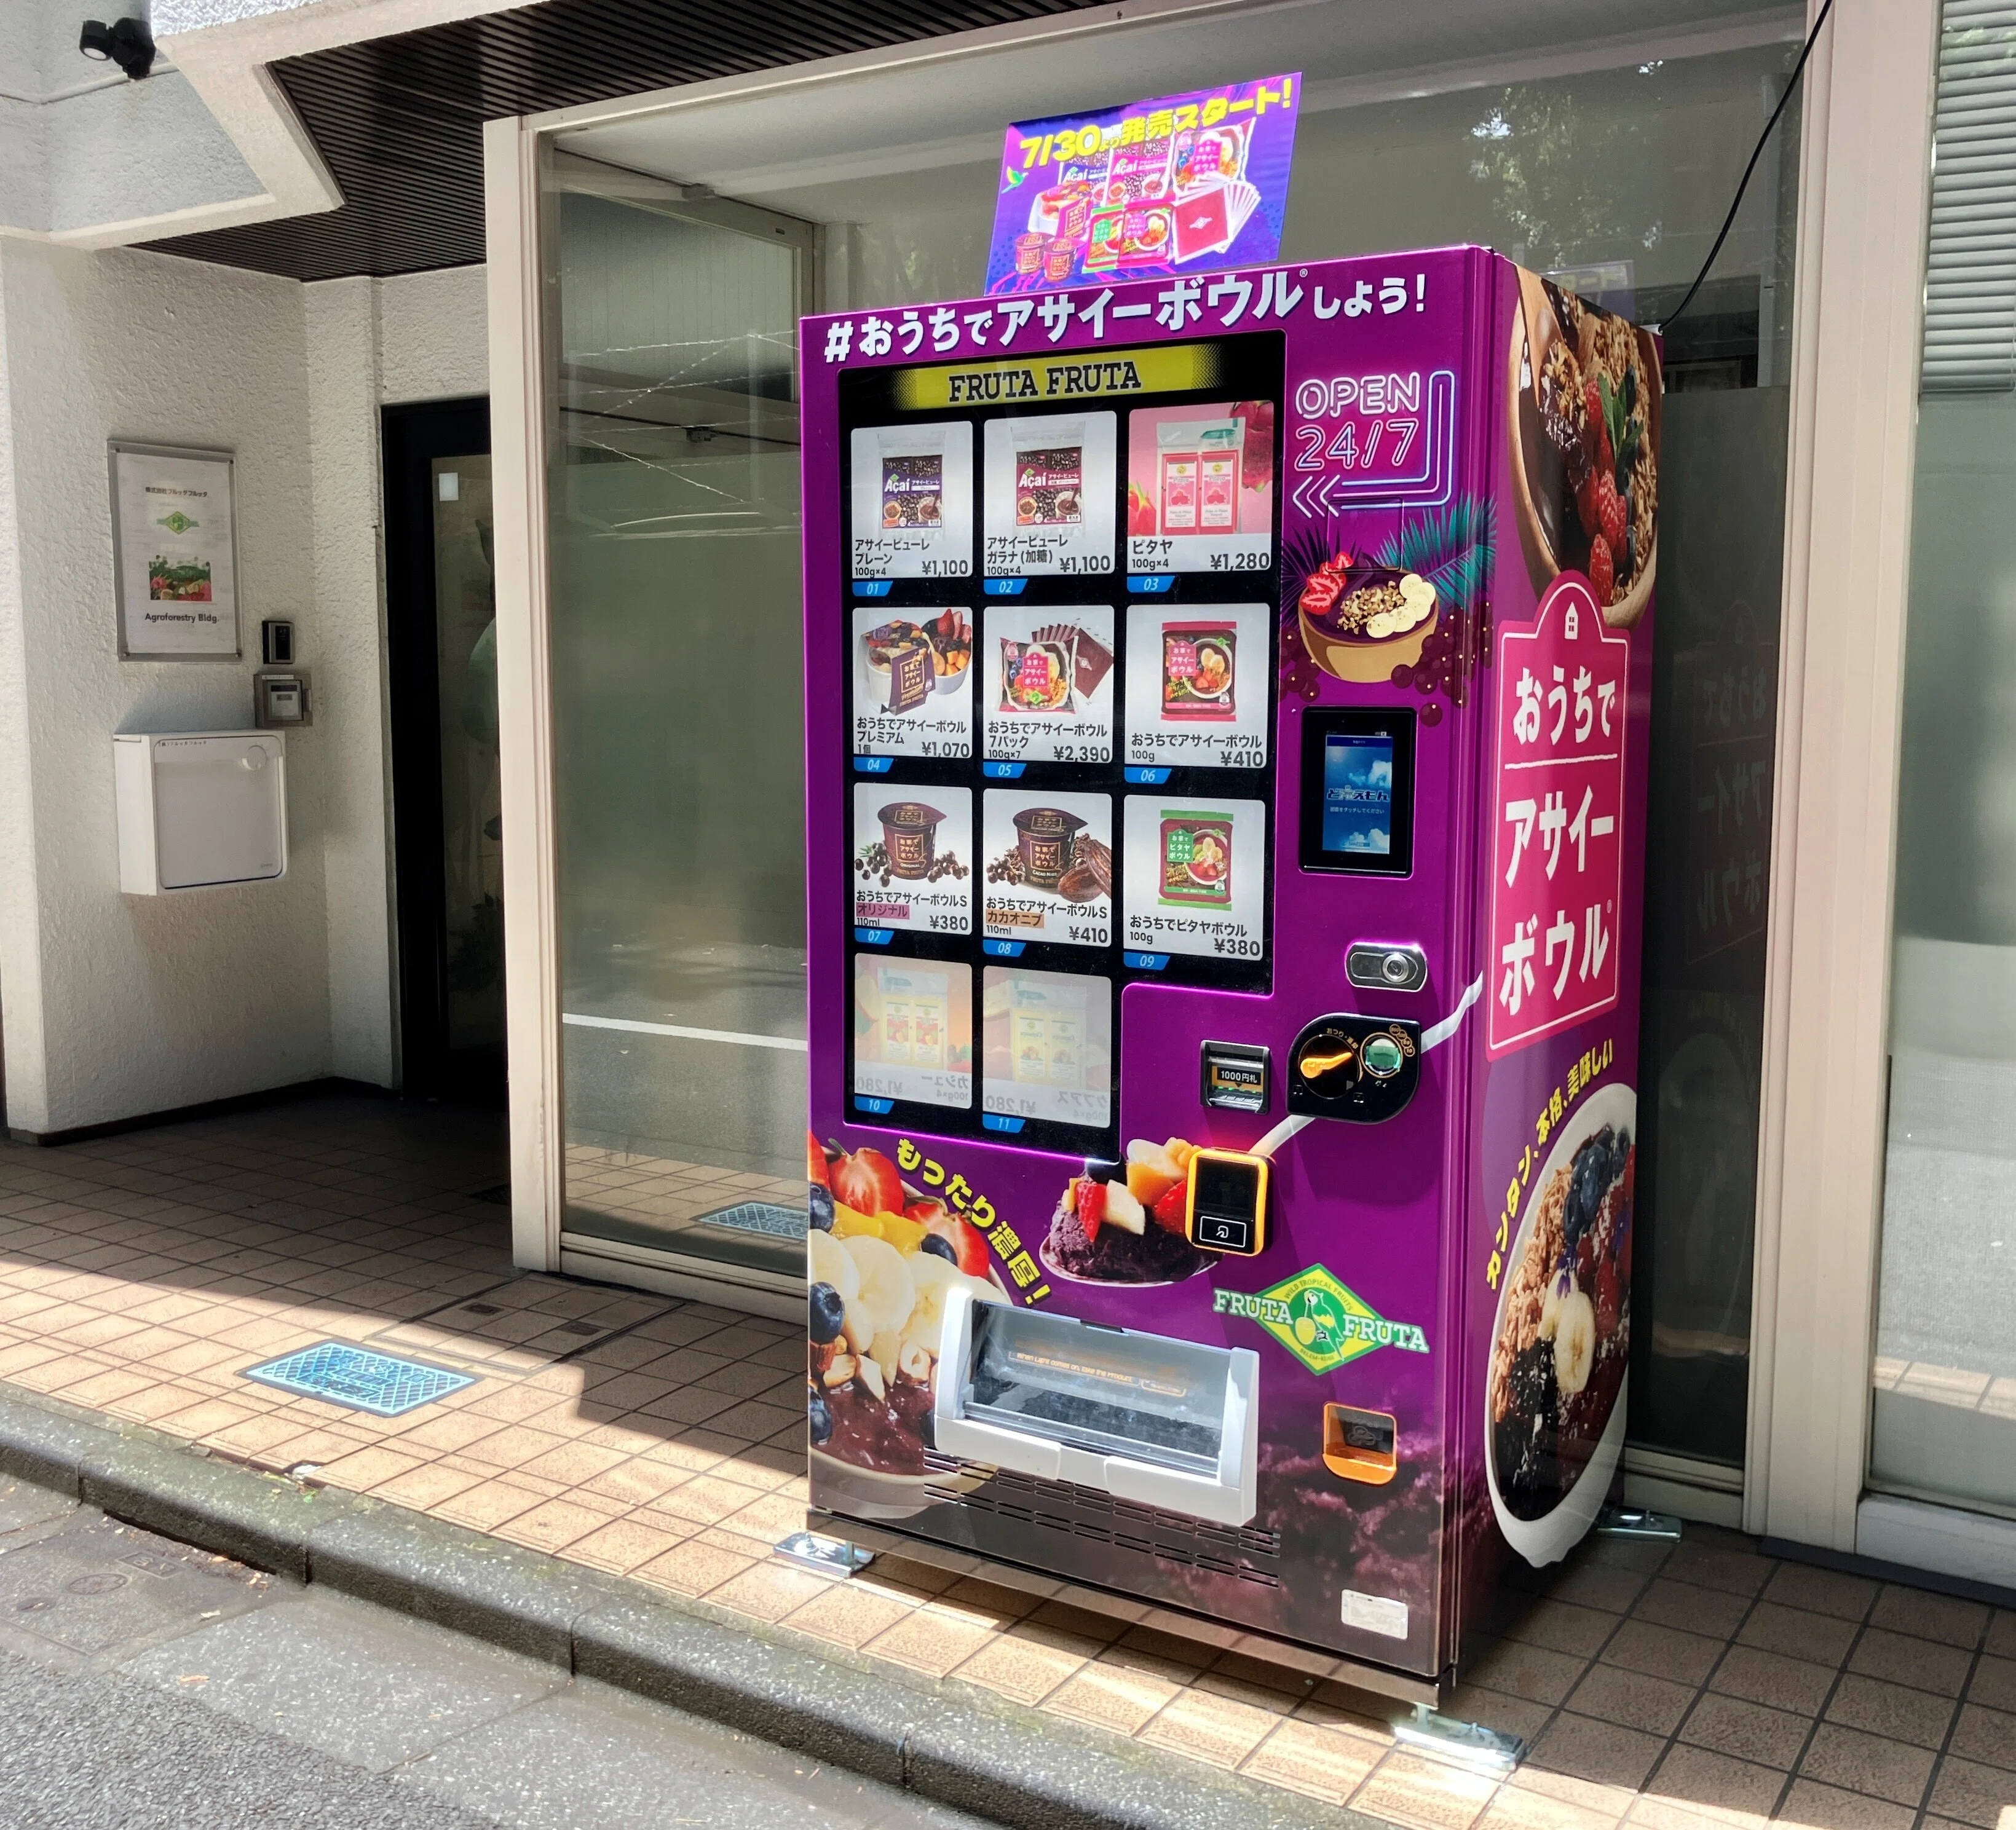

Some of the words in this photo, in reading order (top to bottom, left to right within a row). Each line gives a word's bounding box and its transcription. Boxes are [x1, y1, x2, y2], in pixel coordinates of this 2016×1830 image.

[949, 368, 1040, 403] FRUTA
[1046, 360, 1142, 395] FRUTA
[1295, 371, 1421, 420] OPEN
[1294, 417, 1419, 472] 24/7
[855, 537, 930, 551] アサイーピューレ
[987, 534, 1068, 550] アサイーピューレ
[1133, 538, 1173, 555] ピタヤ
[922, 559, 968, 577] ¥1,100
[1059, 555, 1111, 575] ¥1,100
[1210, 552, 1270, 572] ¥1,280
[867, 583, 879, 595] 01
[999, 580, 1013, 593] 02
[1144, 577, 1159, 591] 03
[144, 612, 196, 623] Agroforestry
[1512, 664, 1617, 747] おうちで
[857, 716, 967, 734] おうちでアサイーボウル
[988, 720, 1108, 737] おうちでアサイーボウル
[857, 730, 905, 744] プレミアム
[989, 735, 1029, 749] 7パック
[1131, 732, 1263, 749] おうちでアサイーボウル
[922, 741, 970, 758] ¥1,070
[1053, 745, 1110, 763] ¥2,390
[1131, 749, 1155, 763] 100g
[867, 759, 880, 771] 04
[1220, 751, 1264, 768] ¥410
[998, 763, 1012, 776] 05
[1140, 769, 1156, 783] 06
[1504, 784, 1615, 889] アサイー
[856, 889, 968, 907] おうちでアサイーボウルS
[858, 904, 908, 918] オリジナル
[986, 896, 1108, 919] おうちでアサイーボウルS
[929, 914, 969, 931] ¥380
[987, 910, 1043, 927] カカオニブ
[1129, 914, 1247, 938] おうちでピタヤボウル
[868, 930, 881, 942] 07
[986, 924, 1012, 935] 110ml
[1069, 925, 1109, 944] ¥410
[1129, 931, 1153, 945] 100g
[997, 942, 1012, 955] 08
[1214, 937, 1260, 957] ¥380
[1139, 954, 1155, 968] 09
[1220, 1069, 1259, 1084] 1000円札
[868, 1098, 880, 1111] 10
[998, 1118, 1010, 1130] 11
[1213, 1288, 1294, 1325] FRUTA
[1342, 1314, 1429, 1354] FRUTA
